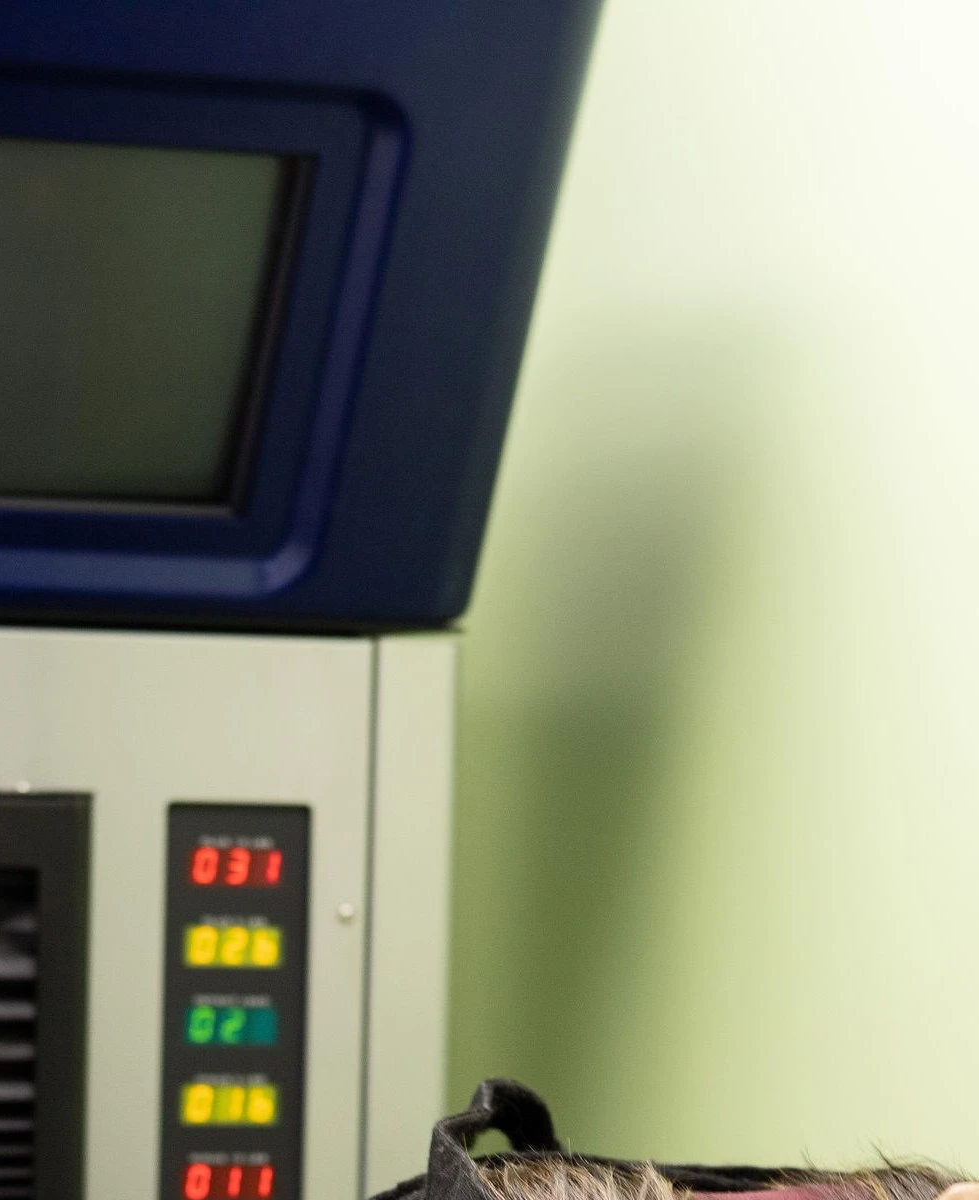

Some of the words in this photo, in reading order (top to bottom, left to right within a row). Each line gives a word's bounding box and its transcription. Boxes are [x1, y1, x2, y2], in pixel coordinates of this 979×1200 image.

[191, 847, 282, 886] 031
[188, 1005, 247, 1043] 02
[185, 1163, 274, 1200] 011
